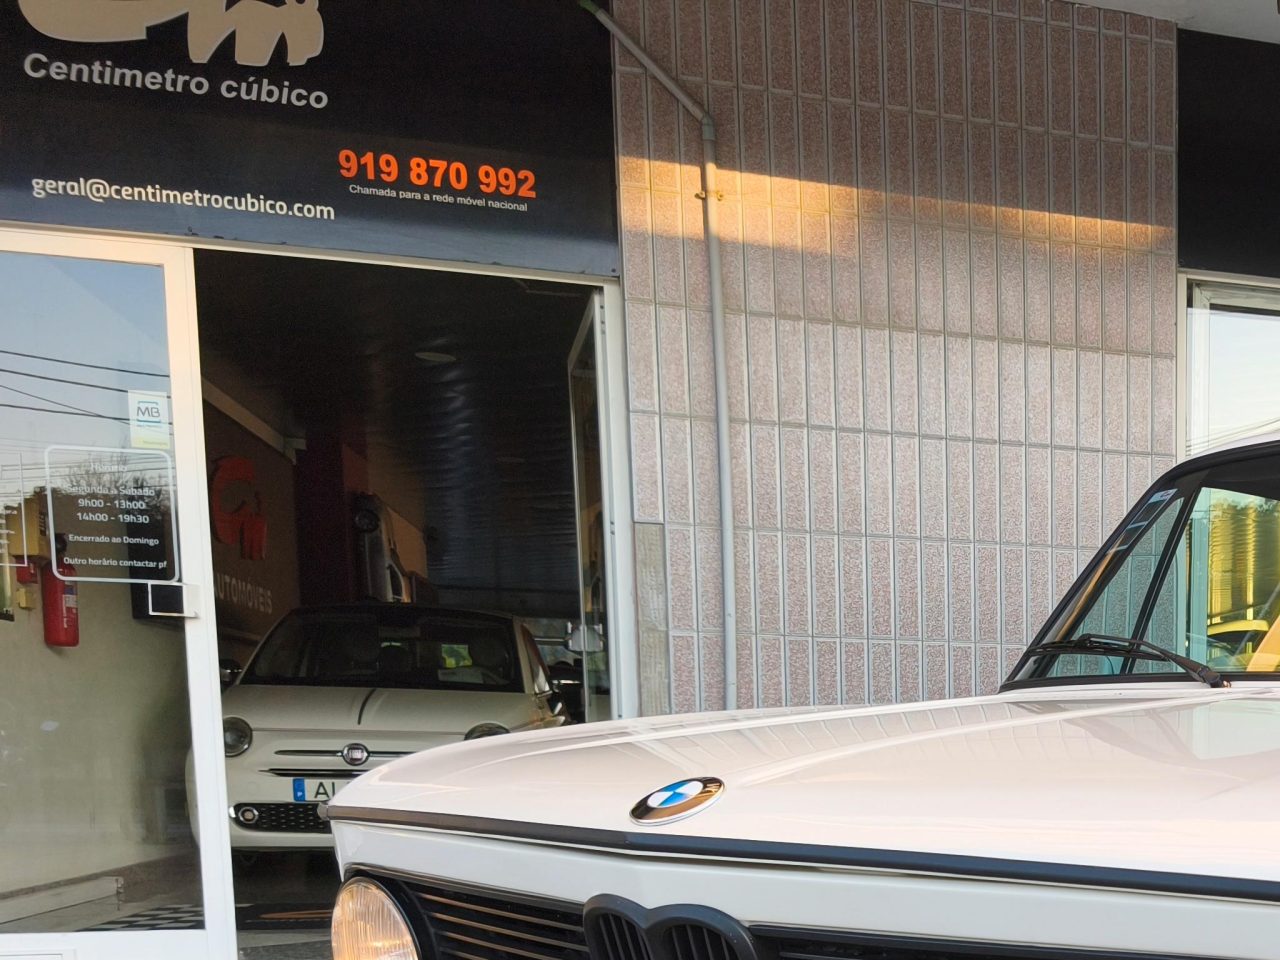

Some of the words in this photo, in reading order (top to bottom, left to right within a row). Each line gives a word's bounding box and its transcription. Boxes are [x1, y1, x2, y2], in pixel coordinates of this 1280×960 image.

[23, 53, 209, 95] Centimetro
[220, 76, 328, 109] cúbico
[338, 149, 399, 183] 919
[409, 157, 468, 190] 870
[478, 165, 536, 198] 992
[31, 177, 335, 220] geral@centimetrocubico.com
[349, 184, 397, 198] Chamada
[399, 190, 421, 201] para
[433, 193, 454, 203] rede
[457, 195, 486, 207] móvel
[488, 199, 528, 212] nacional
[135, 406, 161, 418] MB
[78, 499, 104, 508] 9h00
[114, 500, 146, 510] 13h00
[77, 512, 108, 521] 14h00
[118, 514, 150, 524] 19h30
[68, 534, 110, 543] Encerrado
[123, 535, 159, 547] Domingo
[63, 556, 87, 565] Outro
[119, 560, 157, 568] contactar
[158, 561, 168, 569] pf
